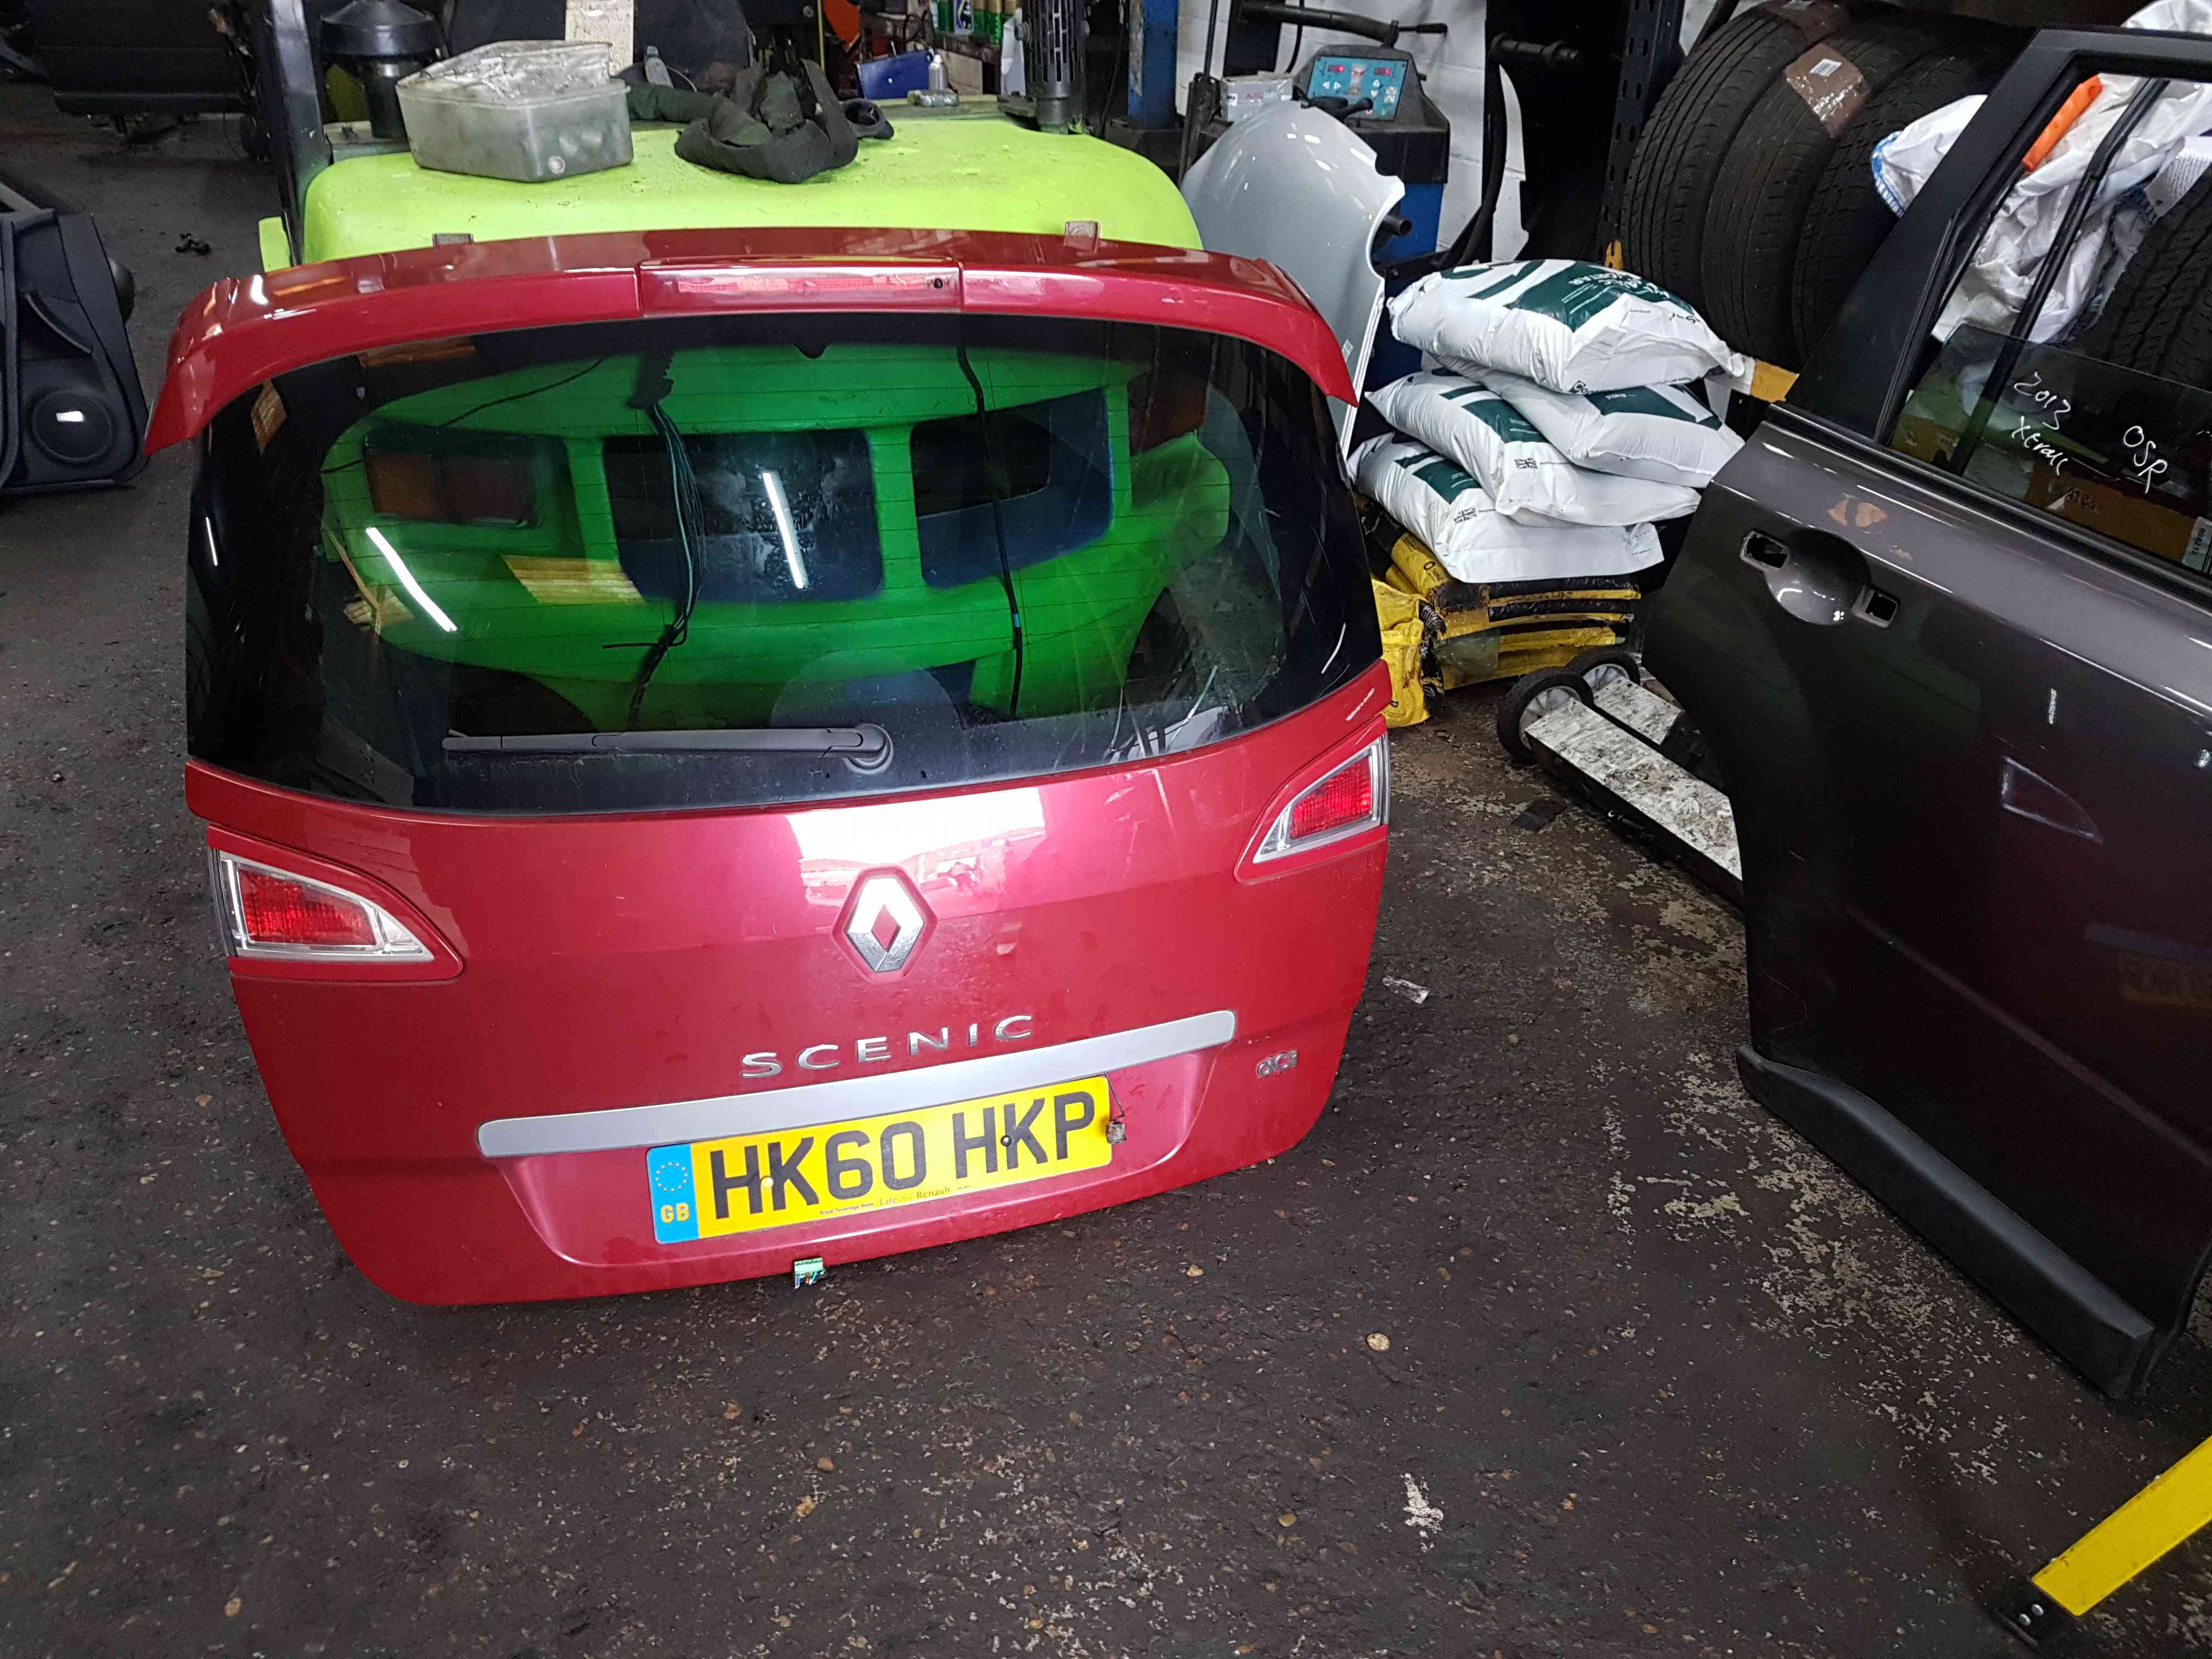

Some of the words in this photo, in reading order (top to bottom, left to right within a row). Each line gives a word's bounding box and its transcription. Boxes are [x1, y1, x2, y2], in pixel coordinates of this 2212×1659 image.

[2014, 371, 2071, 430] 2013
[2123, 426, 2168, 494] OSR
[741, 1014, 1033, 1079] SCENIC
[710, 1121, 927, 1220] HK60
[952, 1091, 1095, 1180] HKP
[660, 1203, 690, 1224] GB
[917, 1187, 950, 1199] Renault
